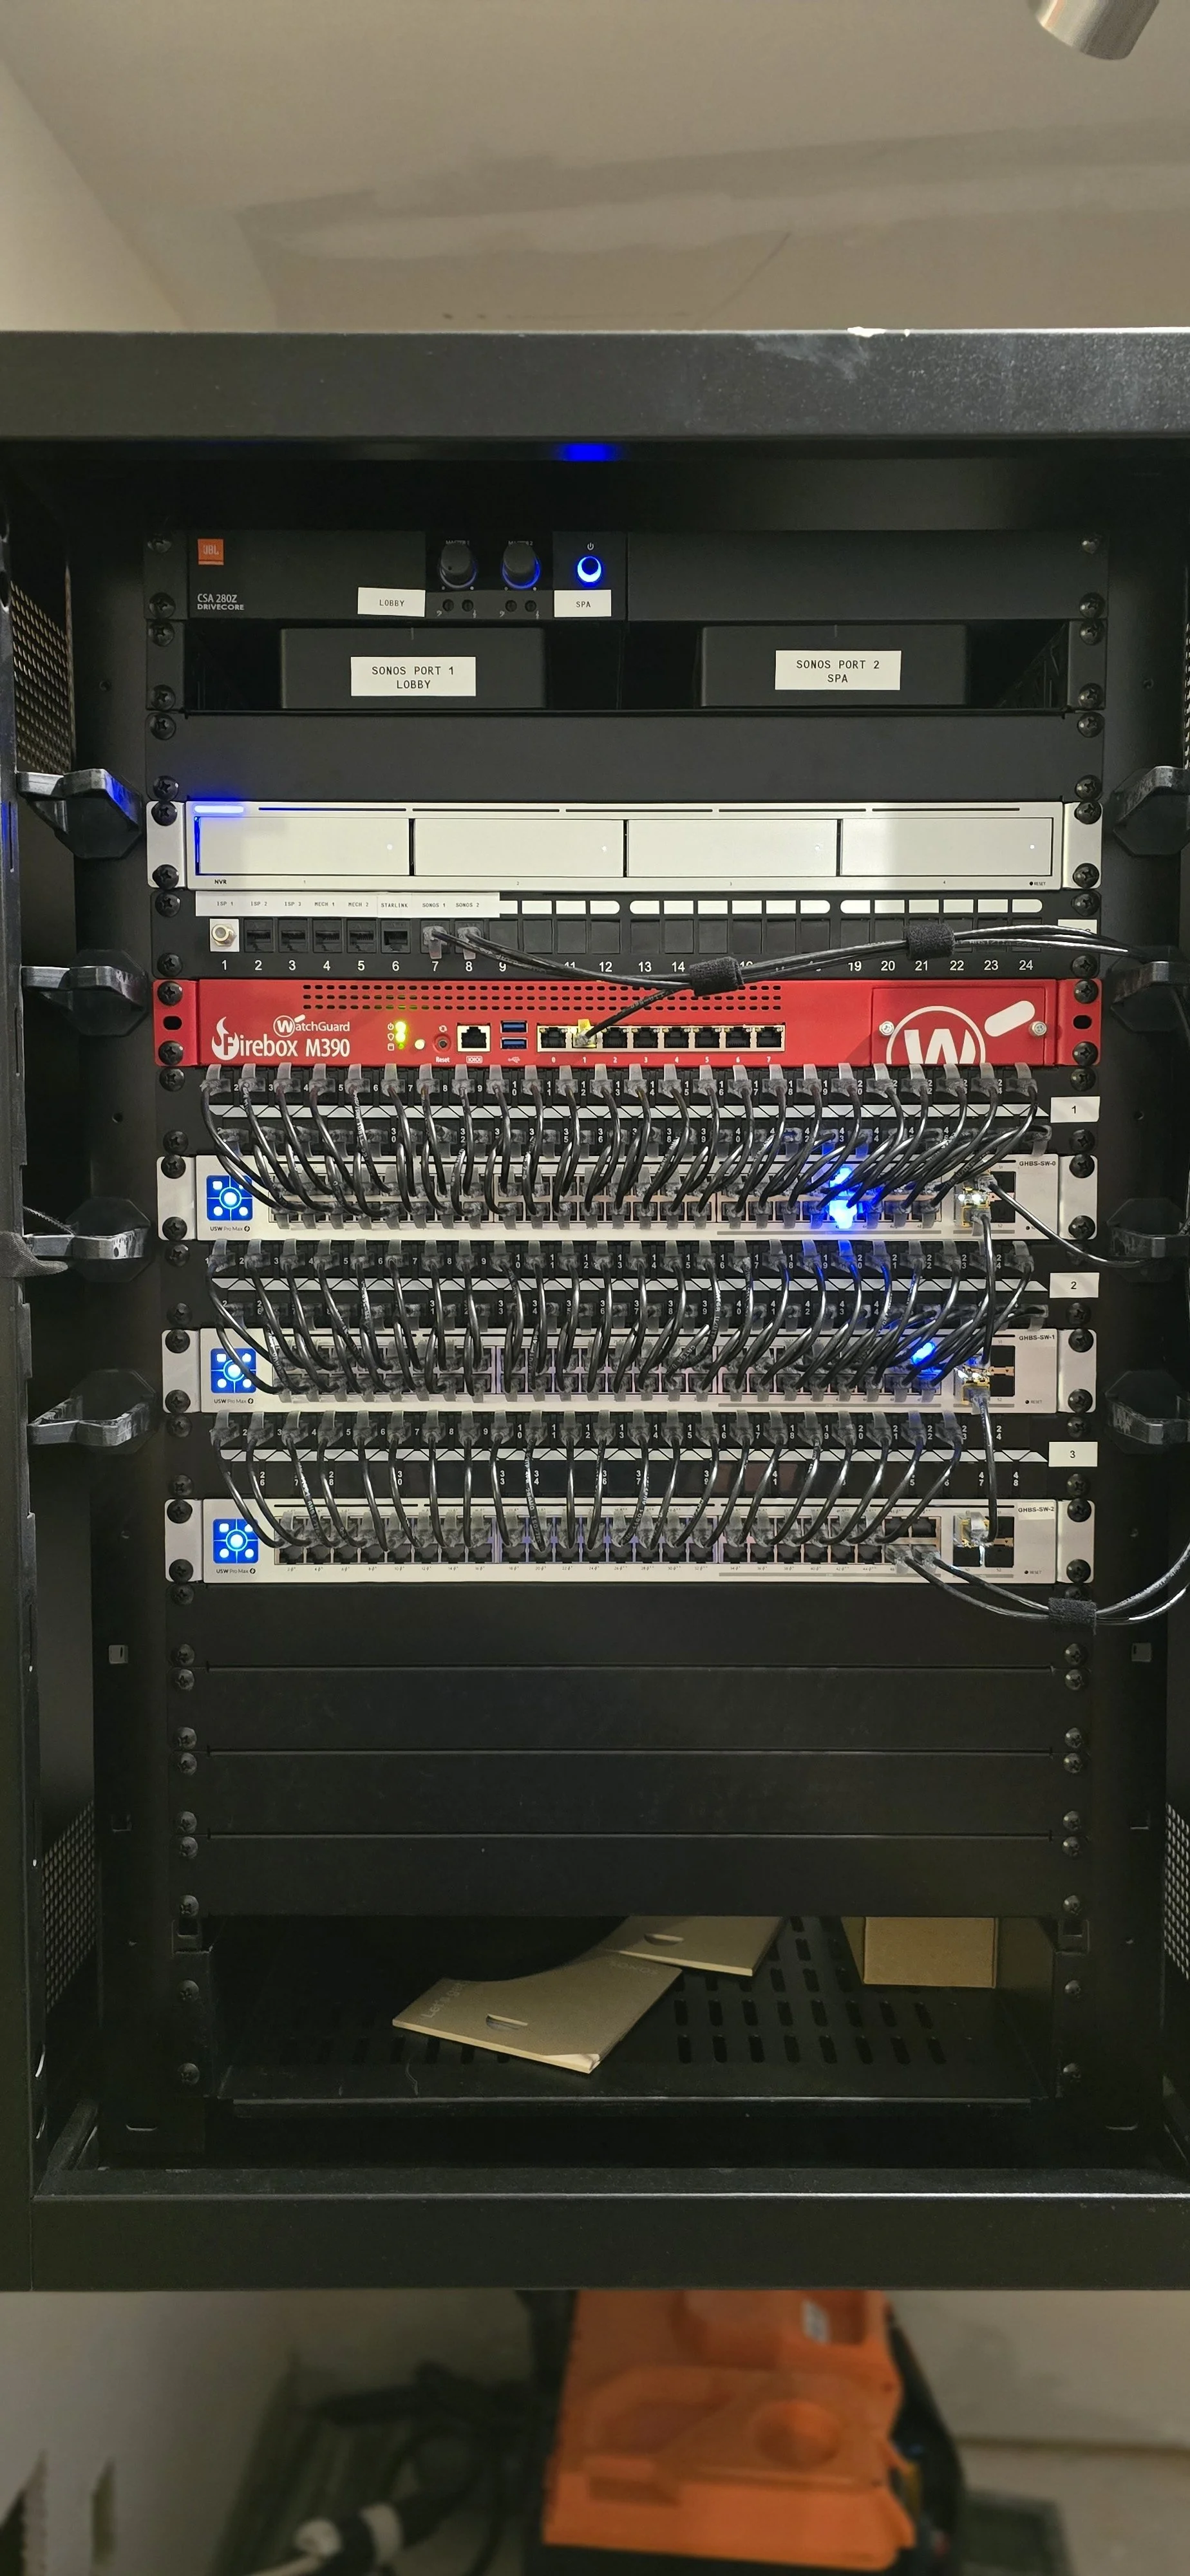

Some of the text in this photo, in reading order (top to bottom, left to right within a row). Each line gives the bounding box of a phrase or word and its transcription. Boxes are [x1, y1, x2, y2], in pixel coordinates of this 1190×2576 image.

[203, 545, 220, 555] JBL
[197, 594, 237, 603] CSA 280Z
[379, 599, 405, 607] LOBBY
[796, 659, 880, 669] SONOS PORT 2
[372, 666, 454, 675] SONOS PORT 1
[827, 674, 848, 683] SPA
[397, 679, 431, 689] LOBBY
[222, 960, 226, 970] 1
[255, 960, 262, 971] 2
[289, 960, 296, 971] 3
[323, 960, 330, 971] 4
[358, 960, 364, 971] 5
[392, 961, 399, 971] 6
[432, 961, 439, 971] 7
[466, 961, 473, 971] 8
[499, 962, 506, 972] 9
[600, 961, 612, 972] 12
[639, 961, 652, 972] 13
[672, 961, 685, 972] 14
[848, 961, 862, 971] 19
[881, 961, 895, 971] 20
[915, 960, 927, 971] 21
[950, 960, 964, 971] 22
[984, 960, 998, 971] 23
[1019, 960, 1033, 970] 24
[273, 1014, 350, 1038] WatchGuard
[212, 1028, 350, 1060] Firebox M390
[1072, 1105, 1076, 1114] 1
[1070, 1281, 1077, 1290] 2
[1070, 1450, 1075, 1459] 3
